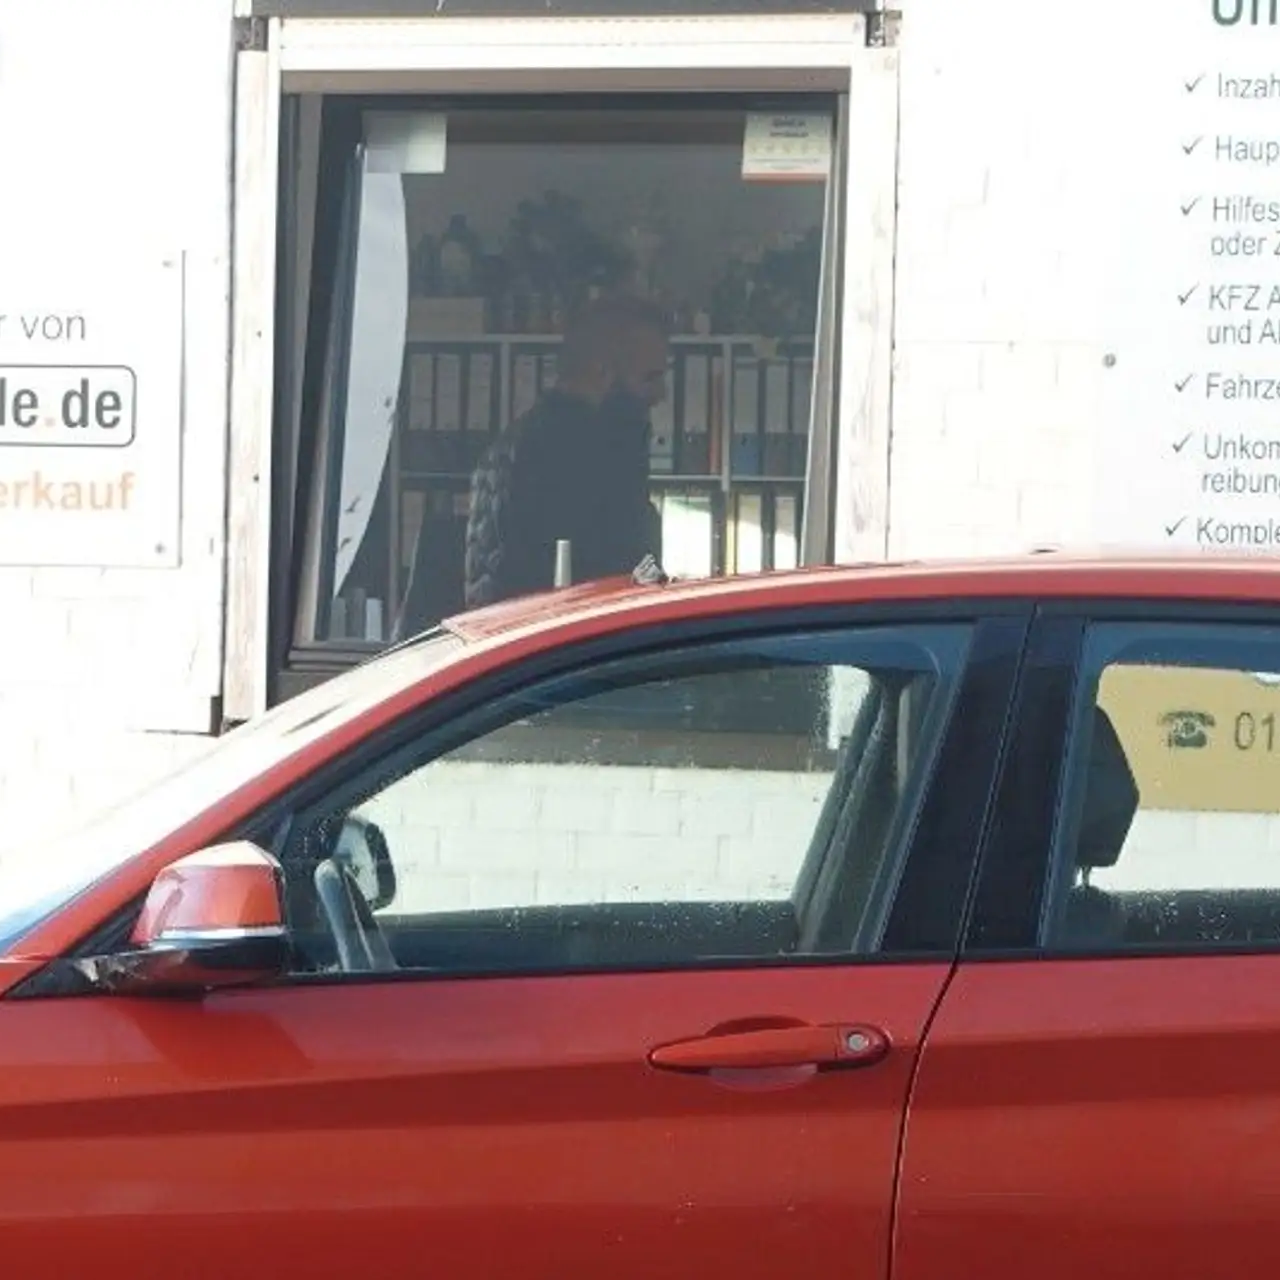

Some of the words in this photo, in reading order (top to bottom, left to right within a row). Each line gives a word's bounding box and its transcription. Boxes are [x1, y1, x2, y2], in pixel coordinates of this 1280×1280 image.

[1210, 230, 1267, 256] oder
[1208, 284, 1260, 312] KFZ
[20, 314, 86, 341] von
[1207, 319, 1252, 345] und
